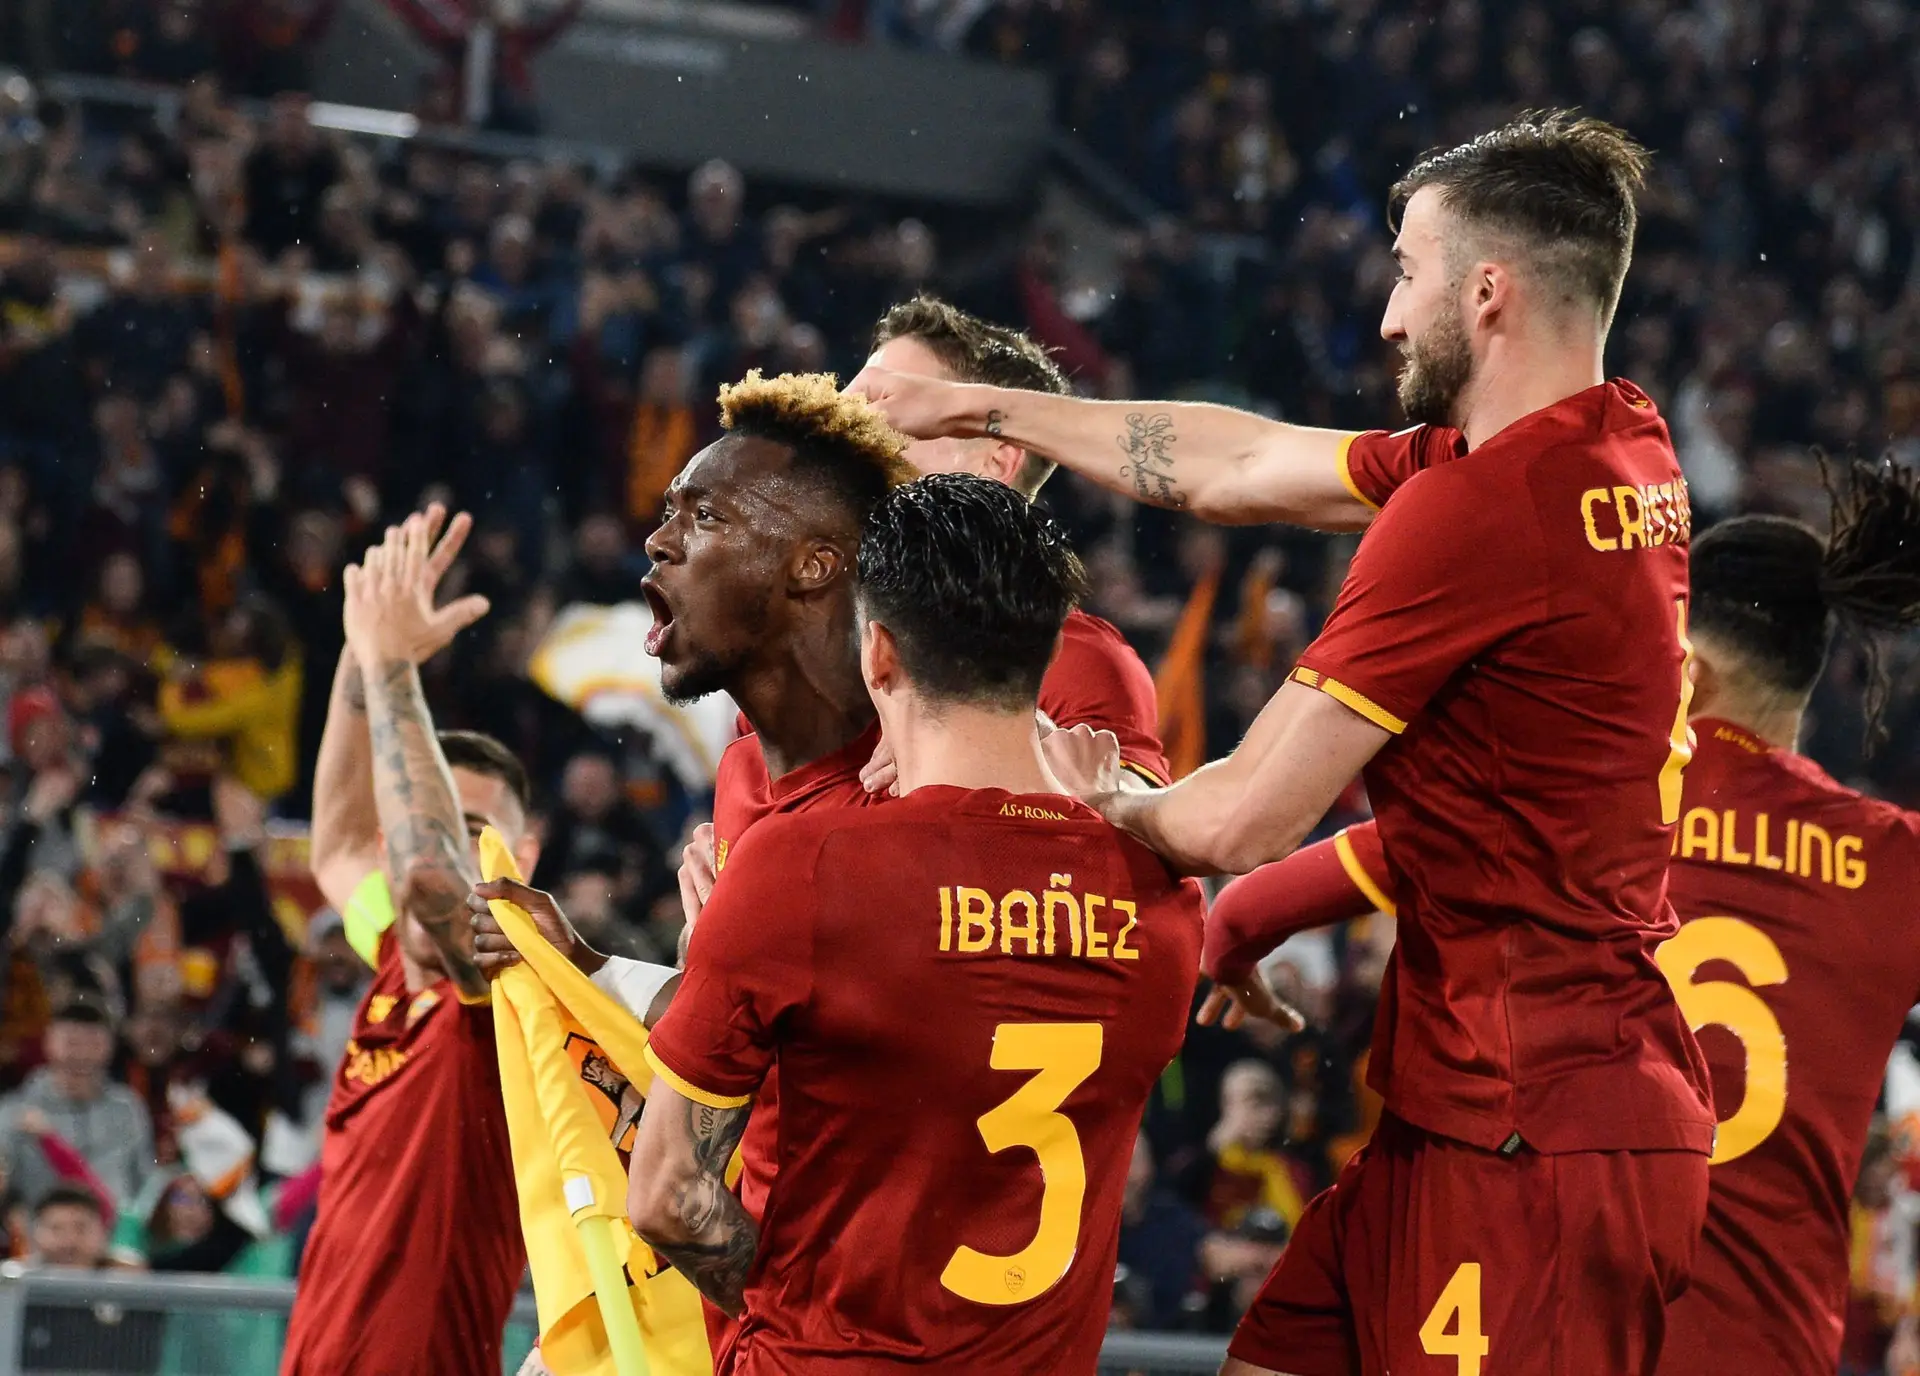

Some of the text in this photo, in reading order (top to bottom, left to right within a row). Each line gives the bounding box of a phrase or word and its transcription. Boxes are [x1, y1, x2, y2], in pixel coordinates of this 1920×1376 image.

[1671, 806, 1867, 889] ALLING
[938, 873, 1139, 959] IBAÑEZ
[1654, 915, 1789, 1166] 6
[940, 1022, 1104, 1306] 3
[1418, 1262, 1489, 1376] 4
